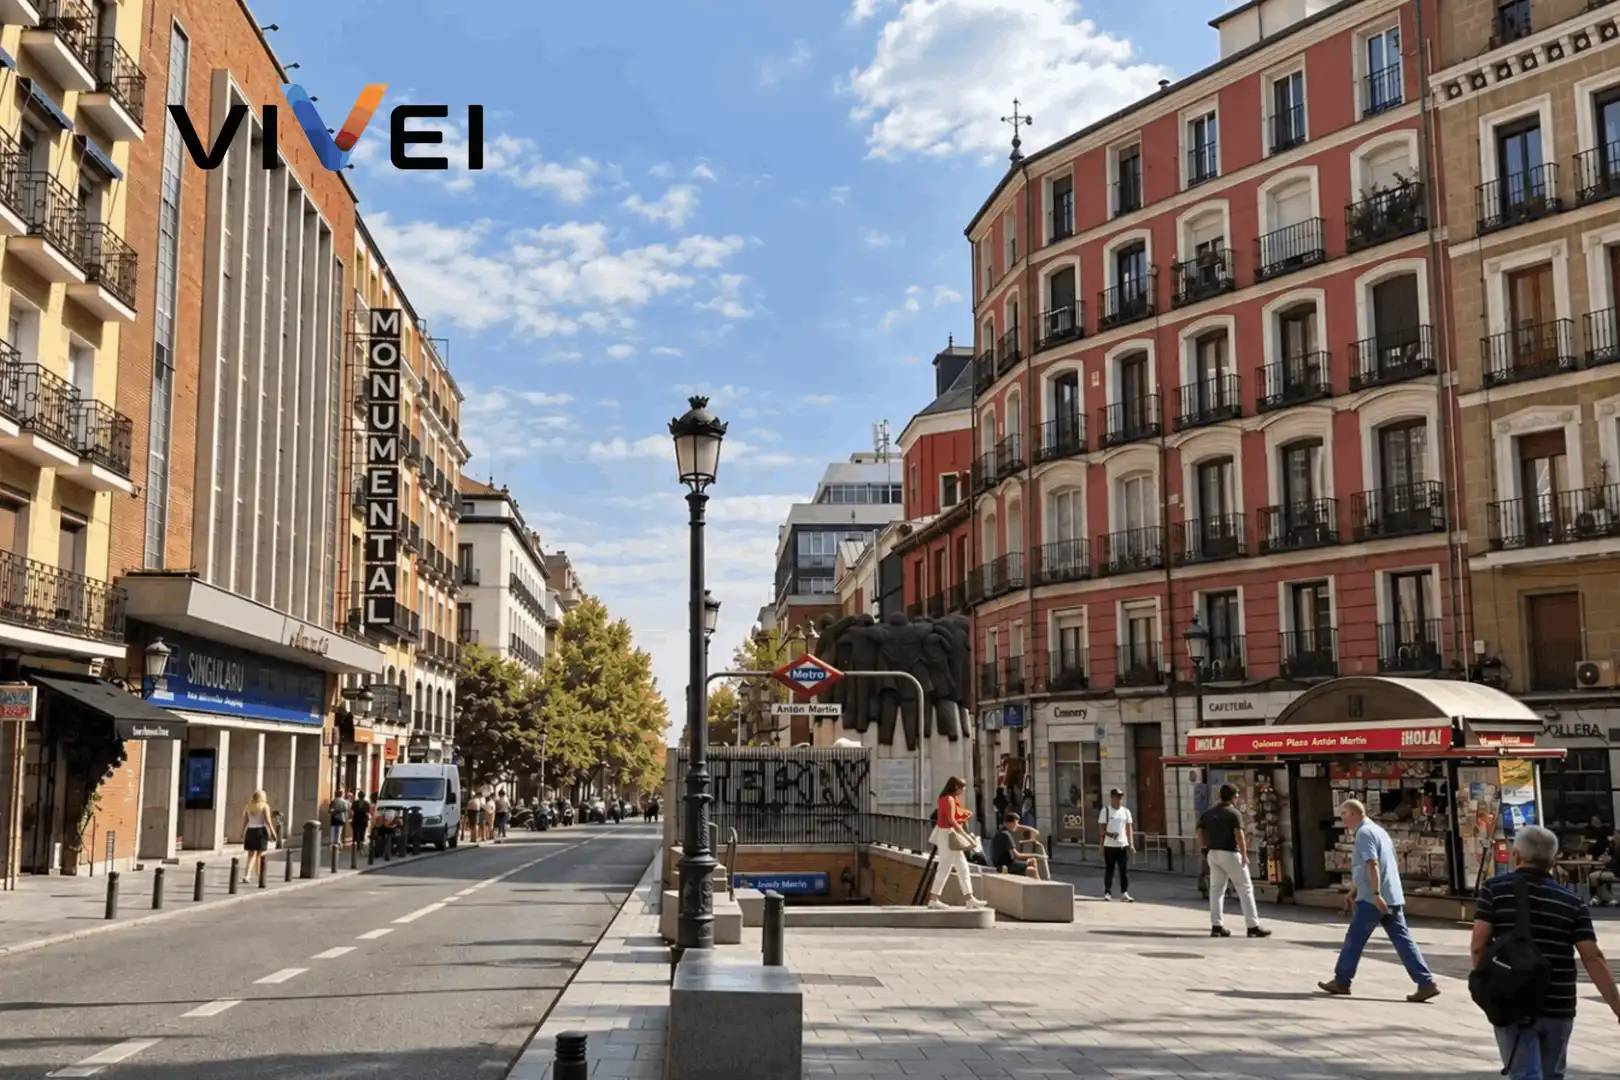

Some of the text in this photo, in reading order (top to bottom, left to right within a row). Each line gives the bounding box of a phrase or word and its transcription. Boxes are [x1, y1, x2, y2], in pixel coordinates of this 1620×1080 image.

[367, 310, 399, 624] MONUMENTAL
[186, 652, 245, 693] SINGULARU
[792, 669, 825, 679] Metro
[1401, 729, 1442, 746] ¡HOLA!
